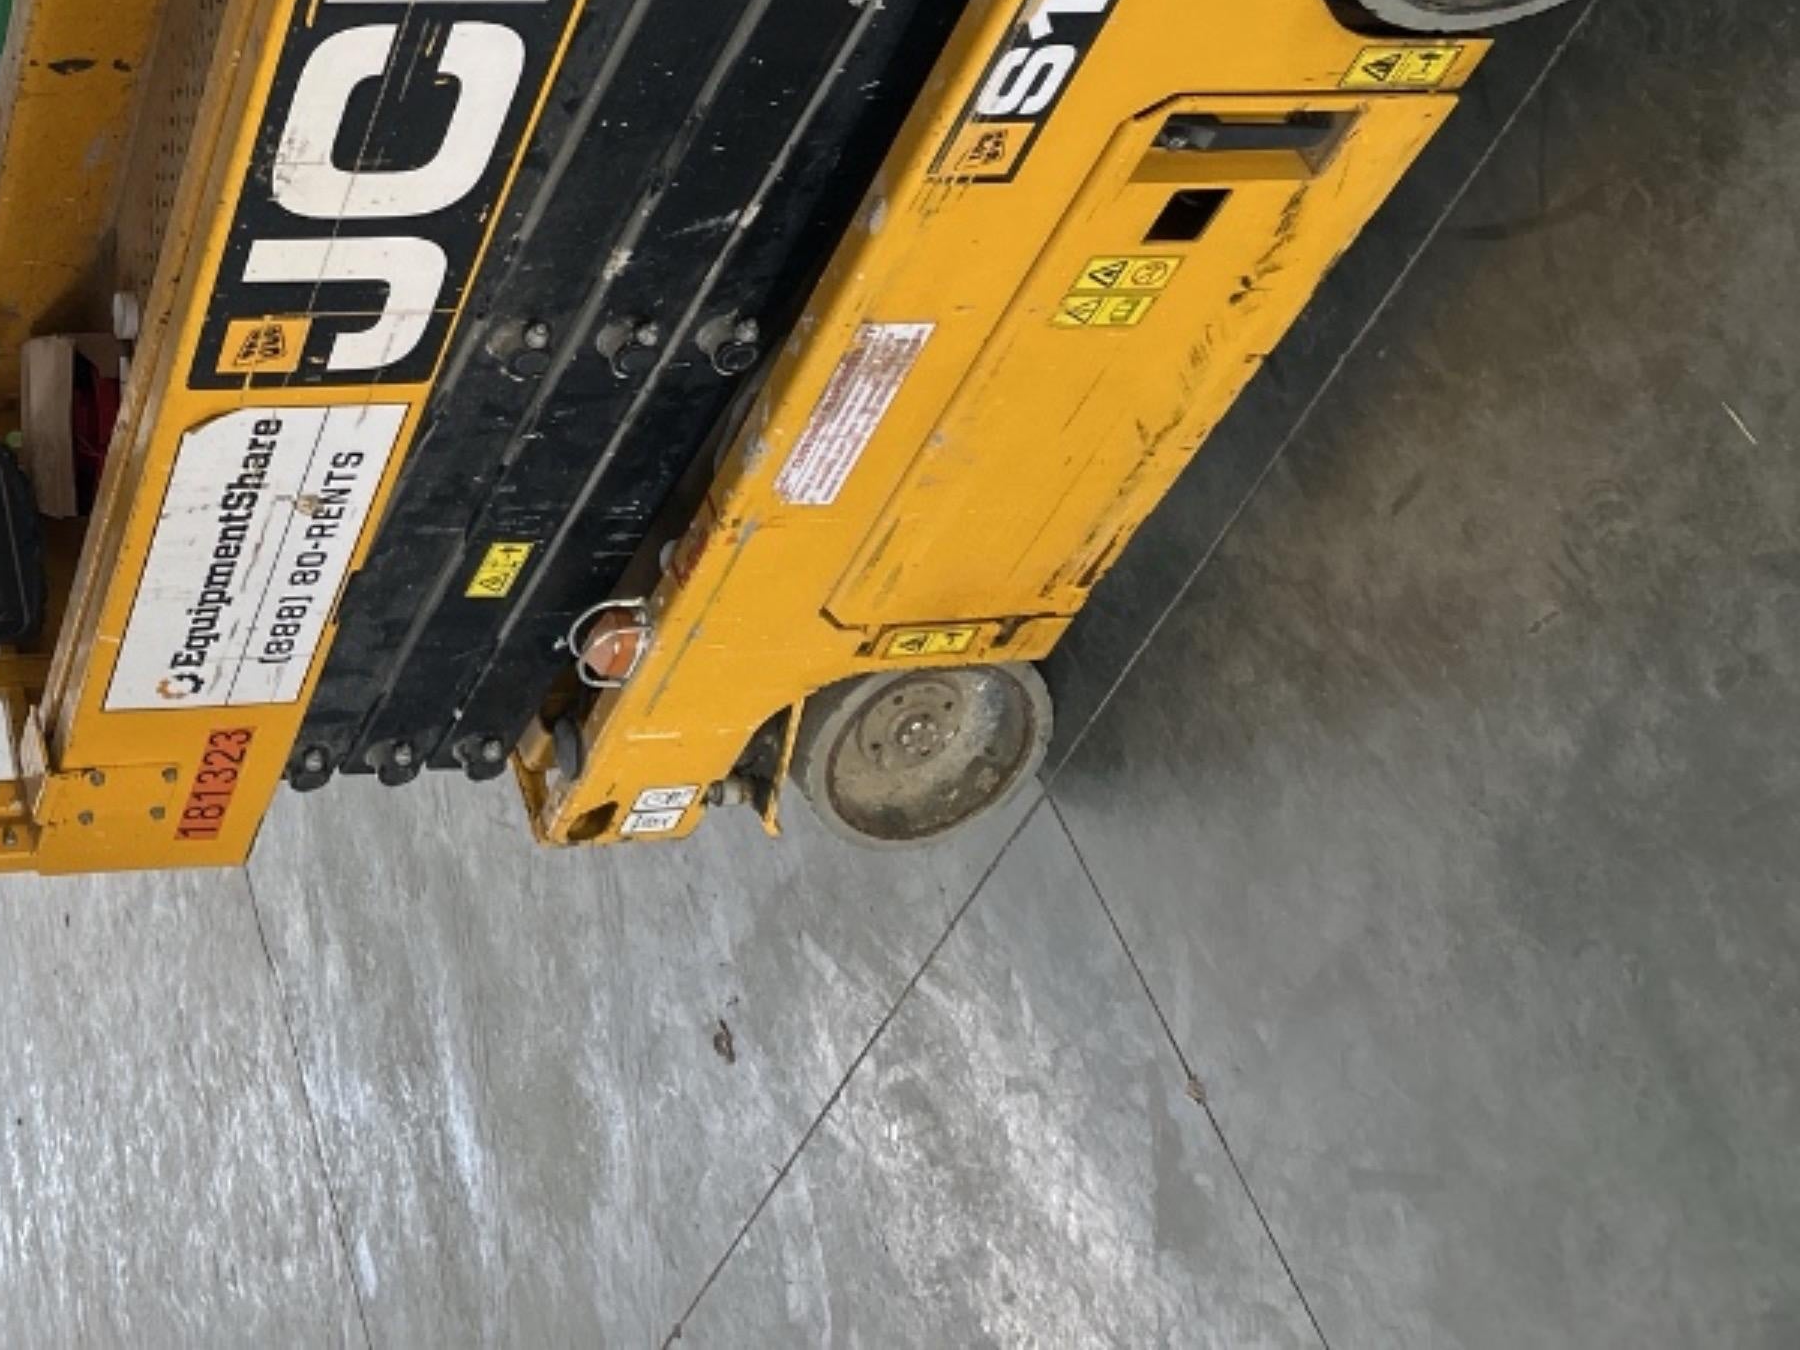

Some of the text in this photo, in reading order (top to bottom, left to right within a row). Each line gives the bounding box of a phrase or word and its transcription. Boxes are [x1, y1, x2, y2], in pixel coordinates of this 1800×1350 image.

[168, 418, 283, 669] EquipmentShare
[256, 450, 365, 664] (888) 80-RENTS
[176, 729, 252, 838] 181323
